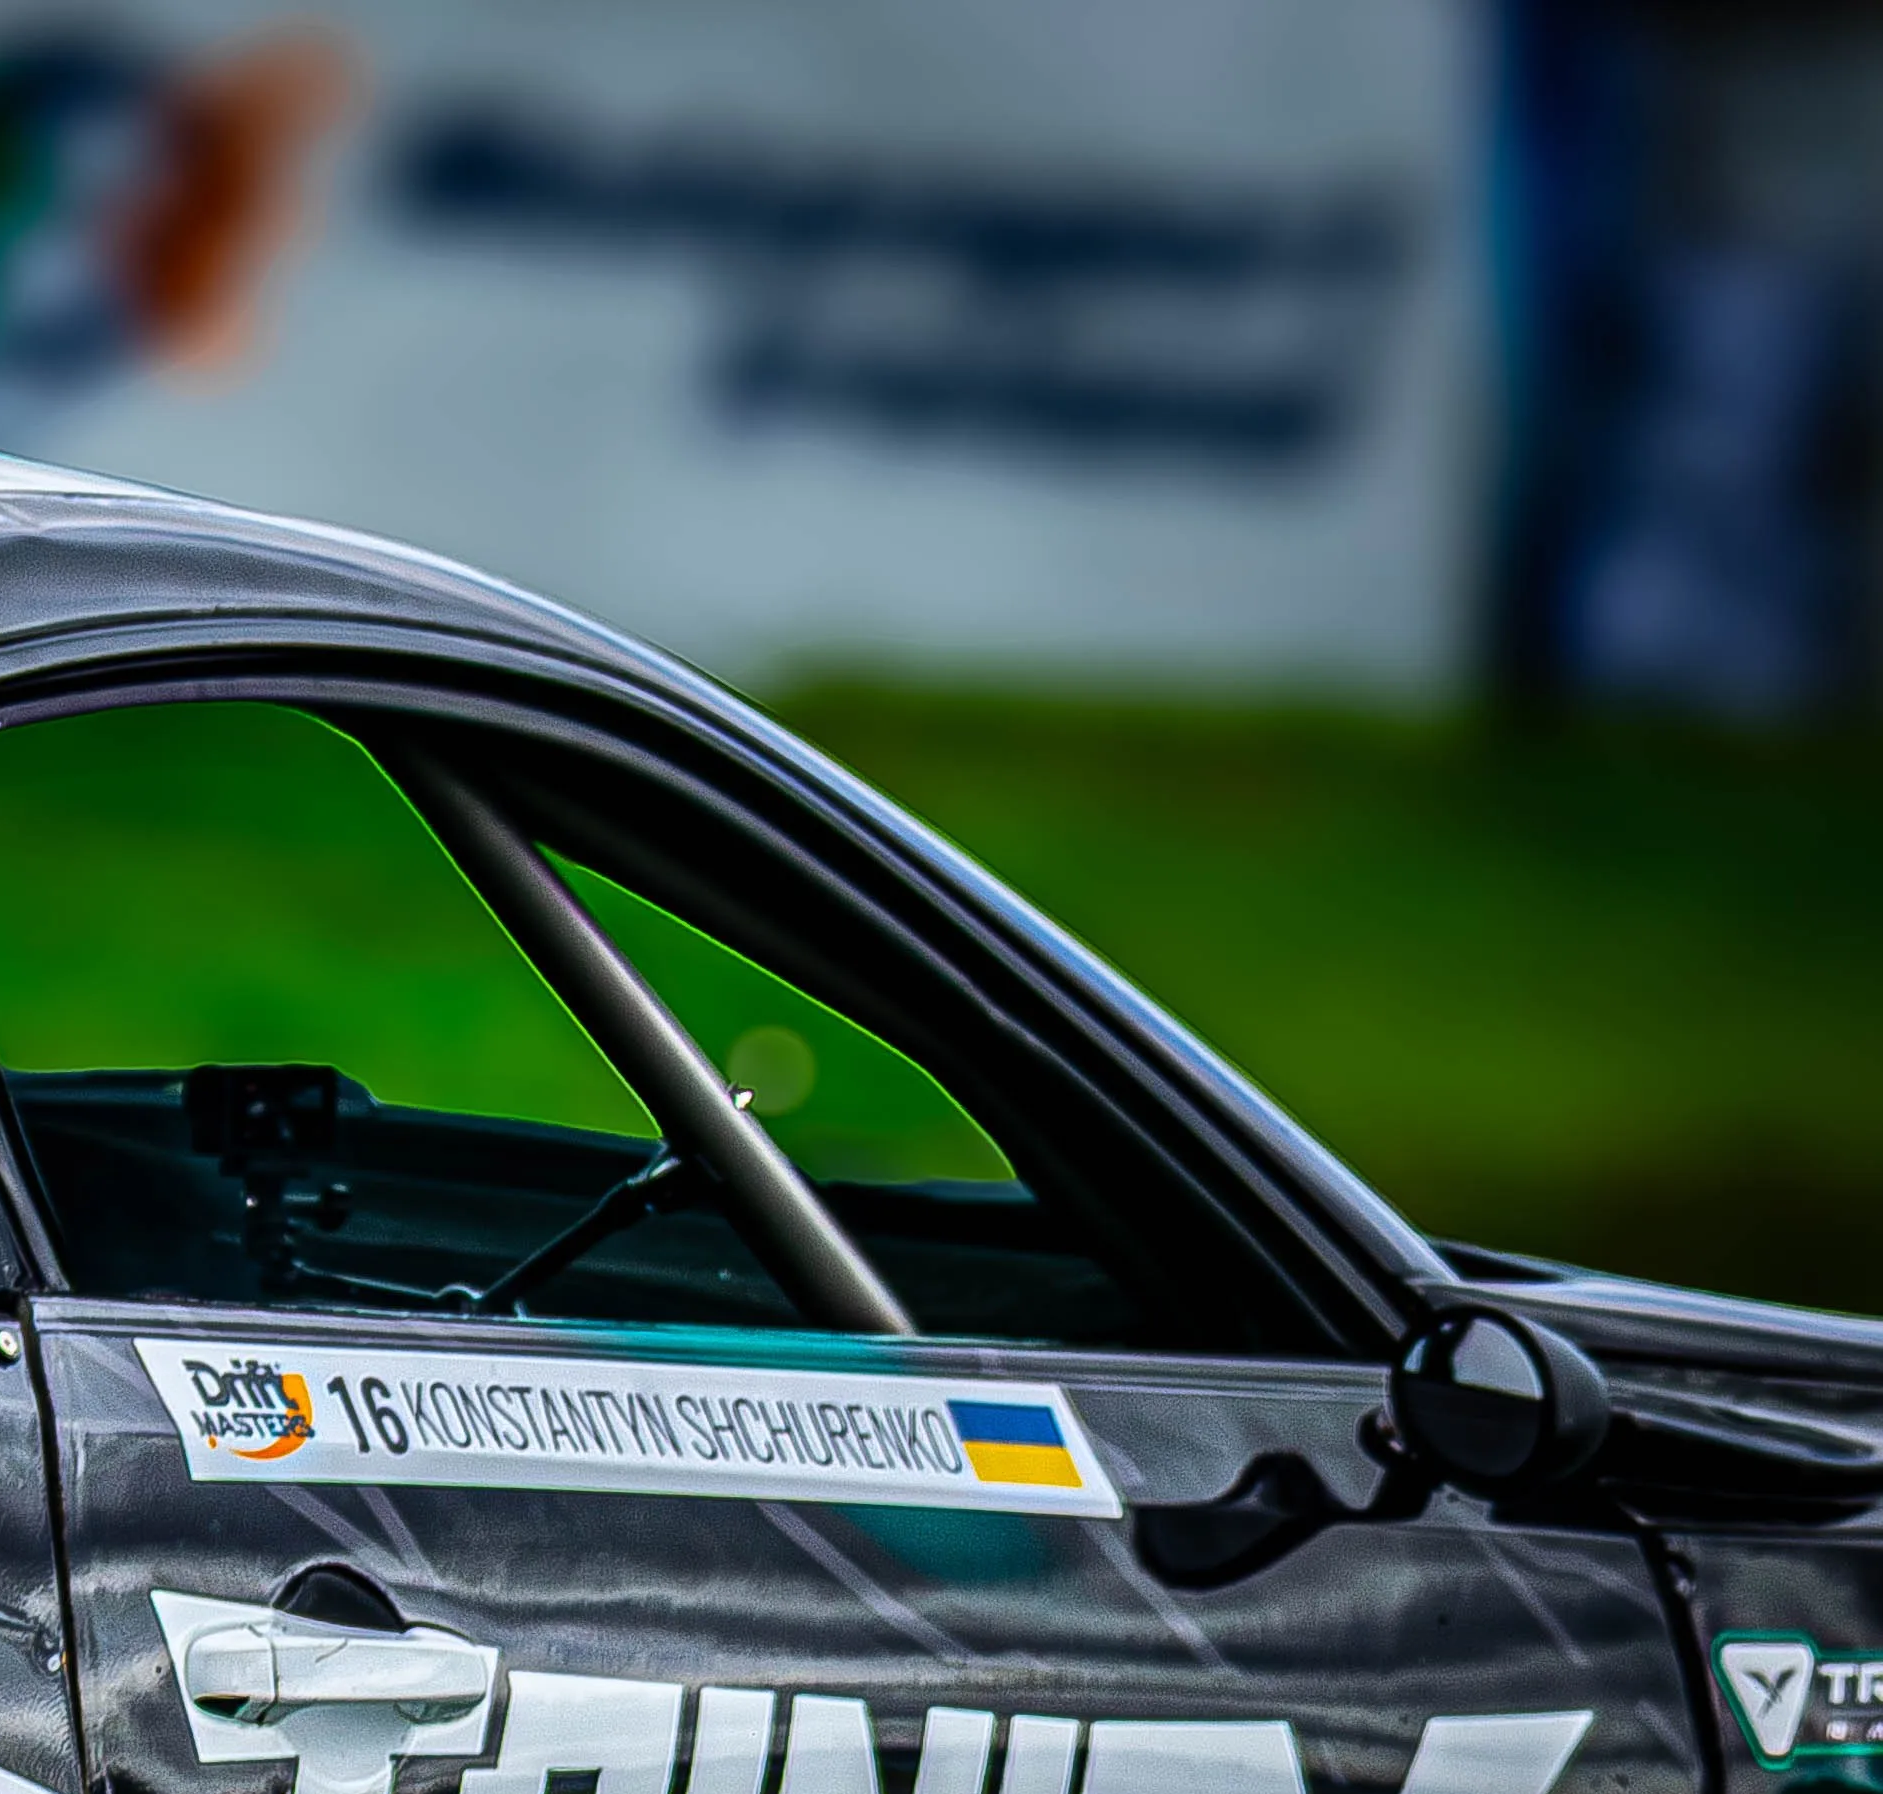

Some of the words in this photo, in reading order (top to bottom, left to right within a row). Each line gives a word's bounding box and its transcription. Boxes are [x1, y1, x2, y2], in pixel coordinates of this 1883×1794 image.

[182, 1358, 300, 1411] Drift
[190, 1410, 315, 1440] MASTERS
[327, 1376, 409, 1455] 16
[400, 1381, 683, 1458] KONSTANTYN
[675, 1395, 963, 1475] SHCHURENKO
